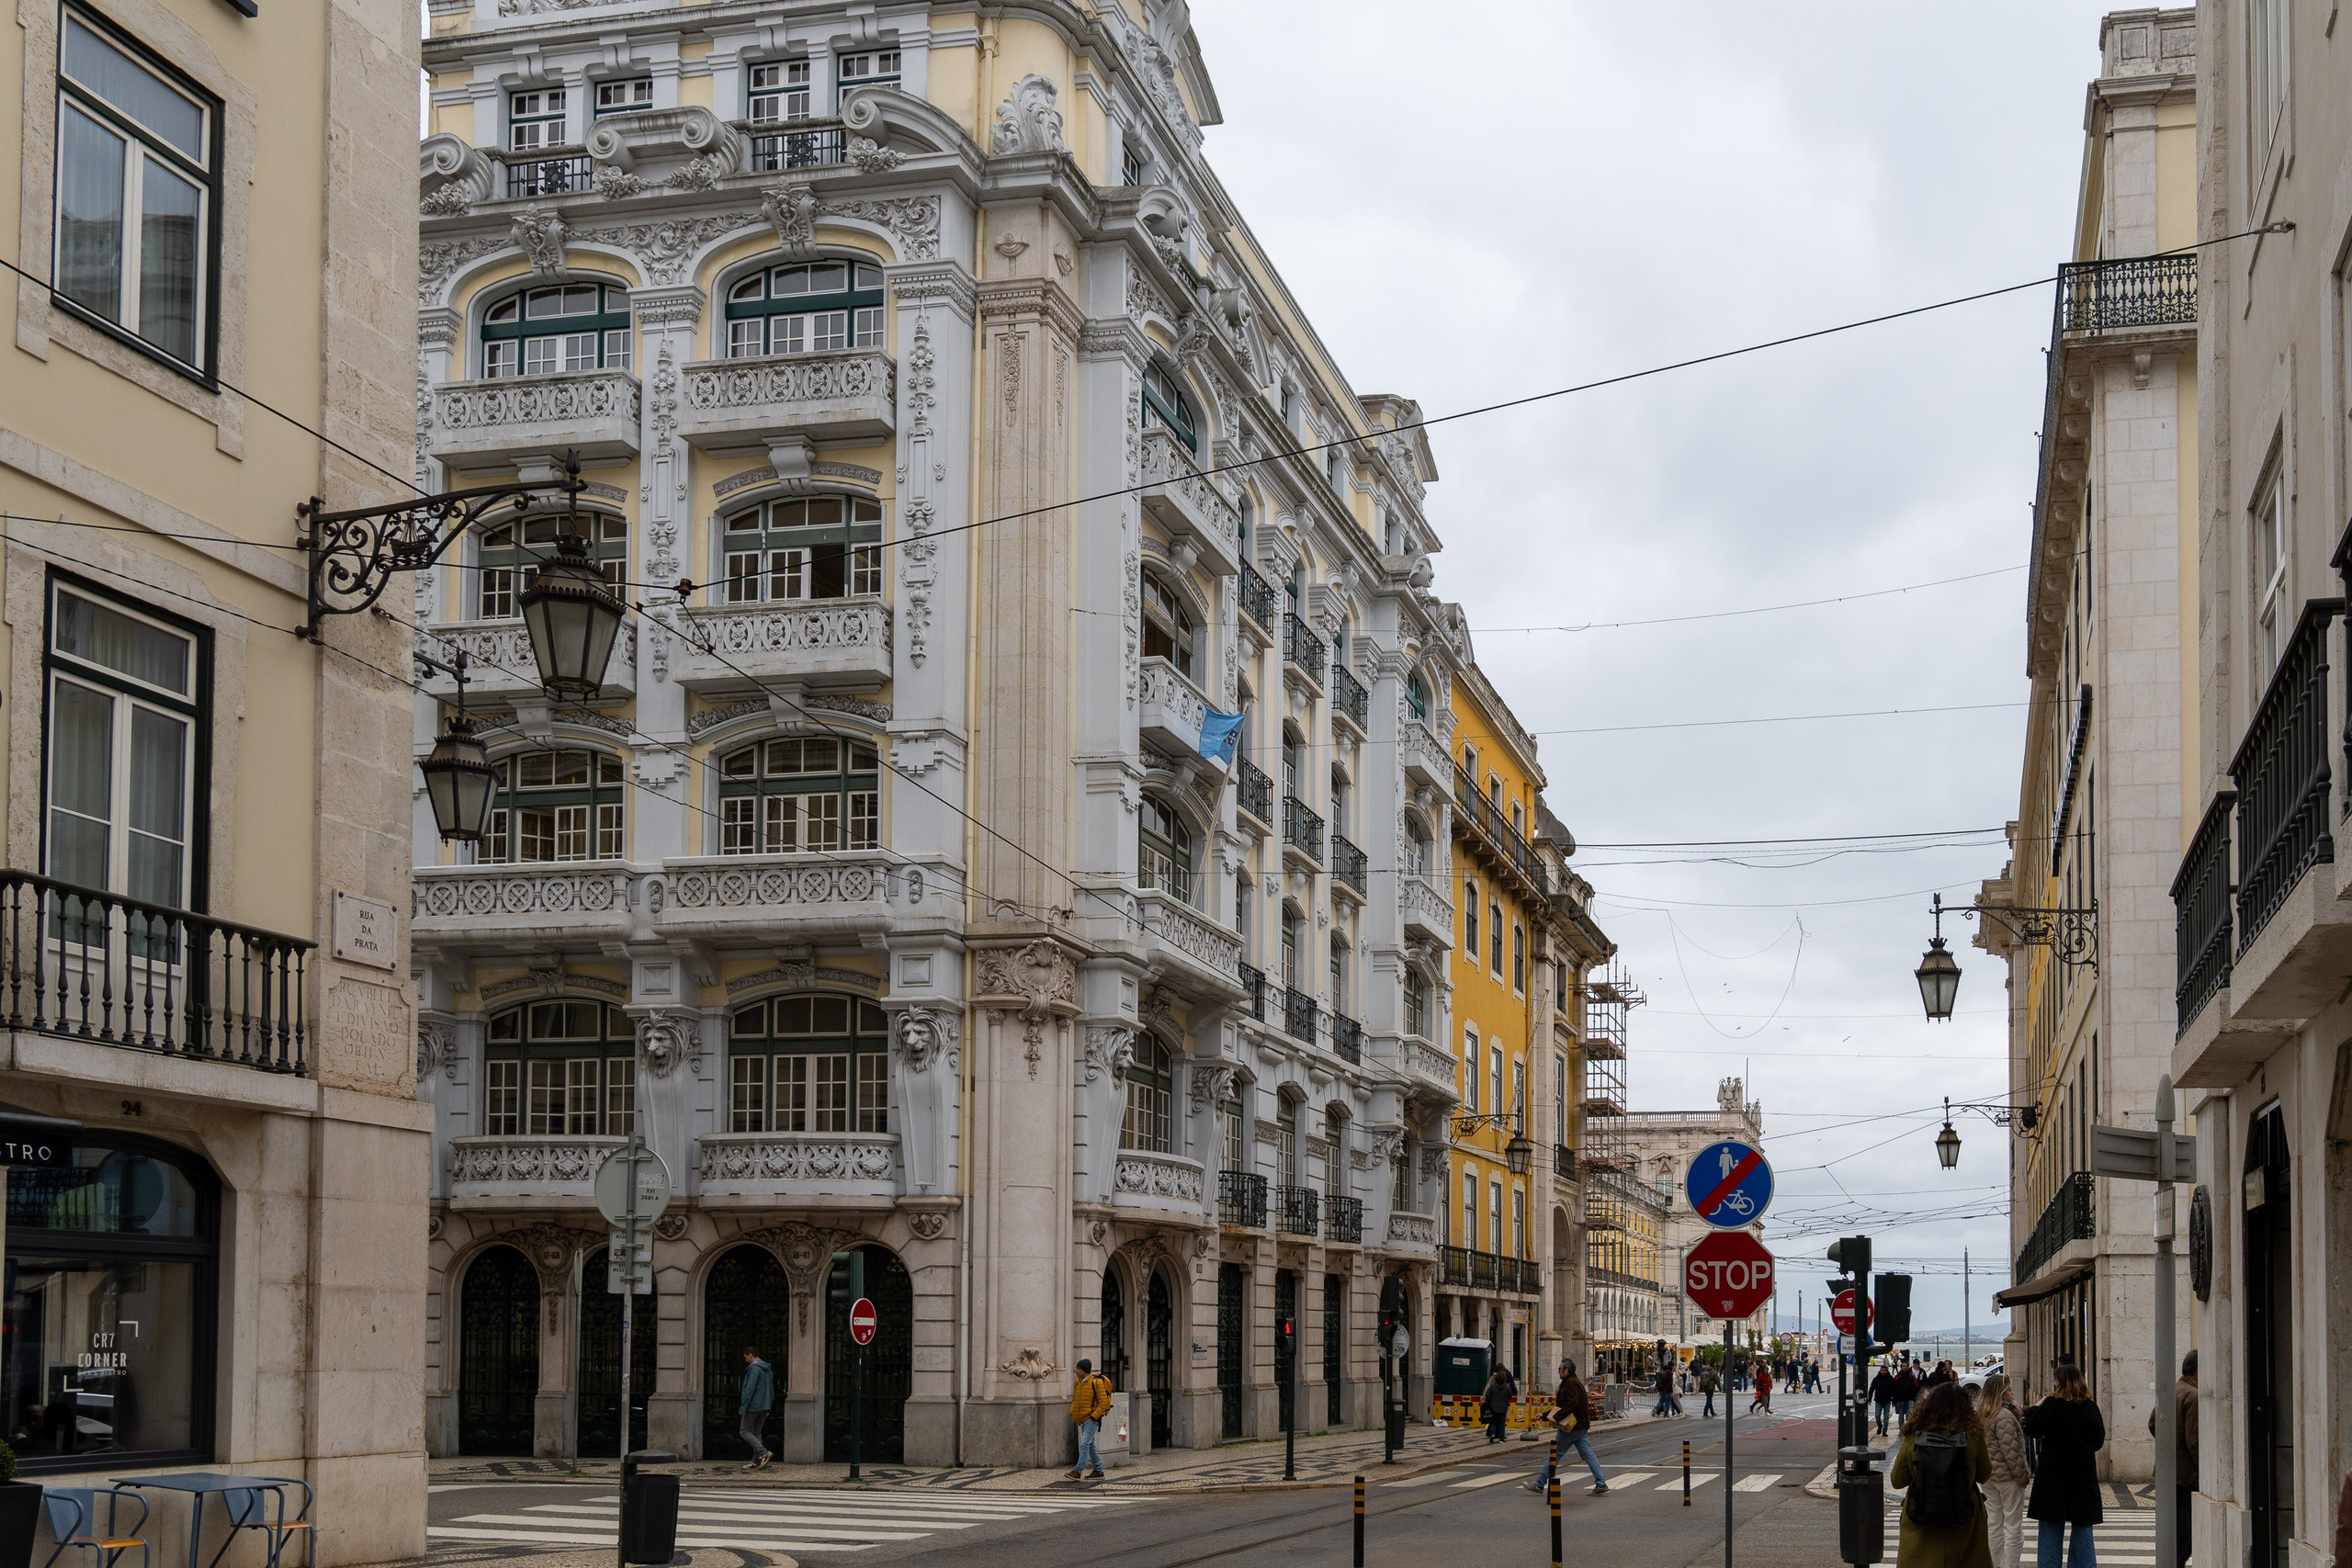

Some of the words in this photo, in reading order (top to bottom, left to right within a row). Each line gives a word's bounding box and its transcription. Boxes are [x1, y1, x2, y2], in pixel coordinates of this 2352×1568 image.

[359, 909, 375, 921] RUA
[361, 925, 372, 935] DA
[355, 938, 379, 952] PRATA
[121, 1100, 142, 1117] 24
[0, 1142, 52, 1161] TRO
[1689, 1260, 1771, 1290] STOP
[94, 1333, 115, 1348] CR7
[77, 1352, 127, 1368] CORNER
